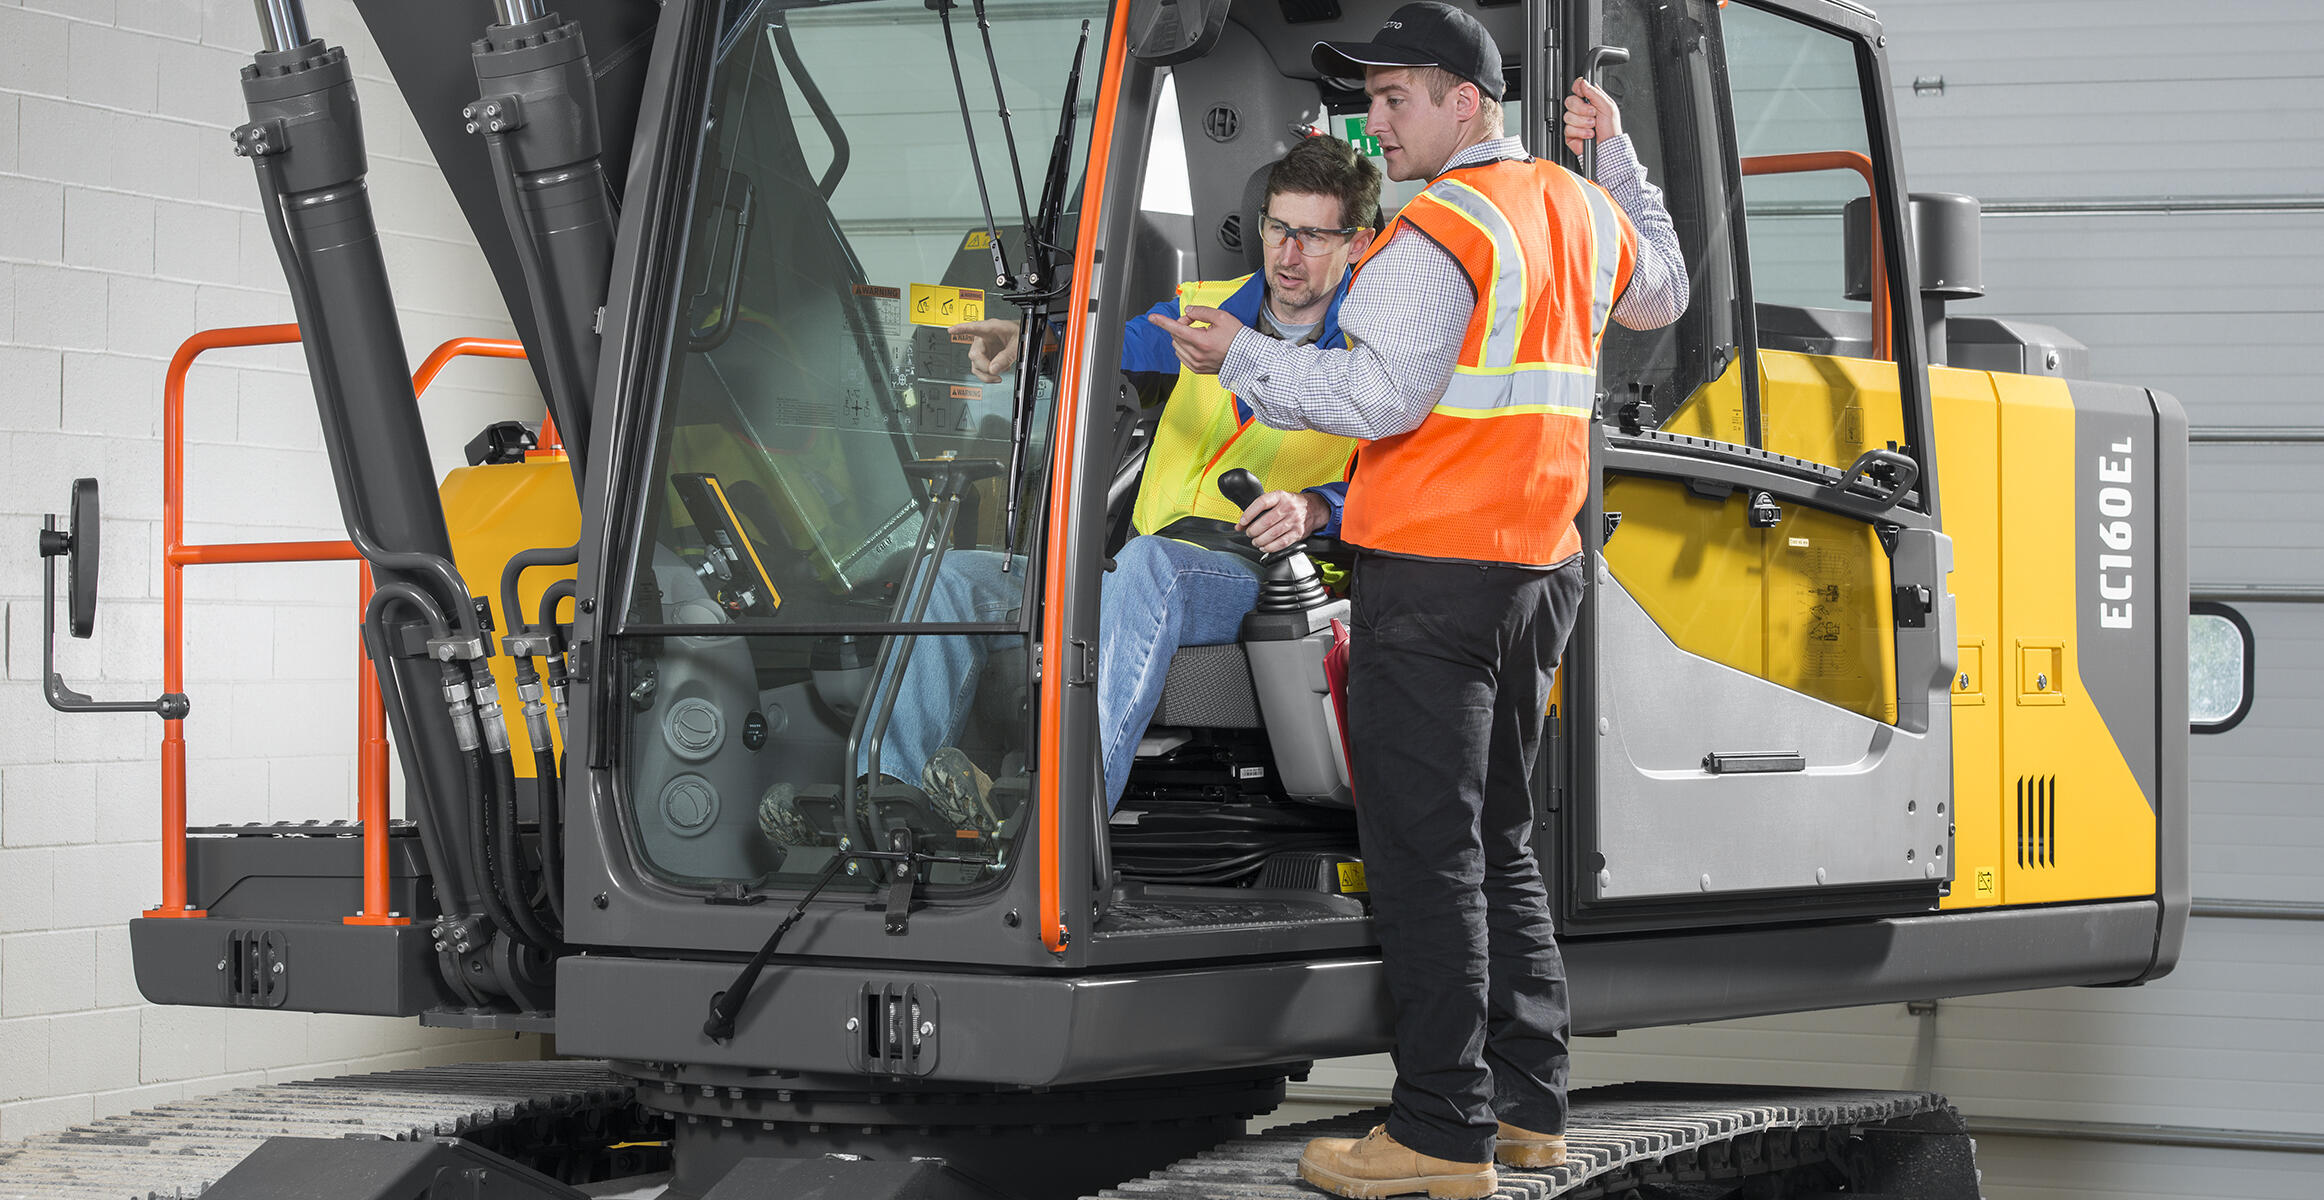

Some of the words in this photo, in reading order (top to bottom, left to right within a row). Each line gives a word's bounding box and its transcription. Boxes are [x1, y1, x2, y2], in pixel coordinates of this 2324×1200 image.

[863, 286, 898, 297] WARNING
[956, 389, 981, 397] WARNING
[2099, 436, 2133, 629] EC160EL
